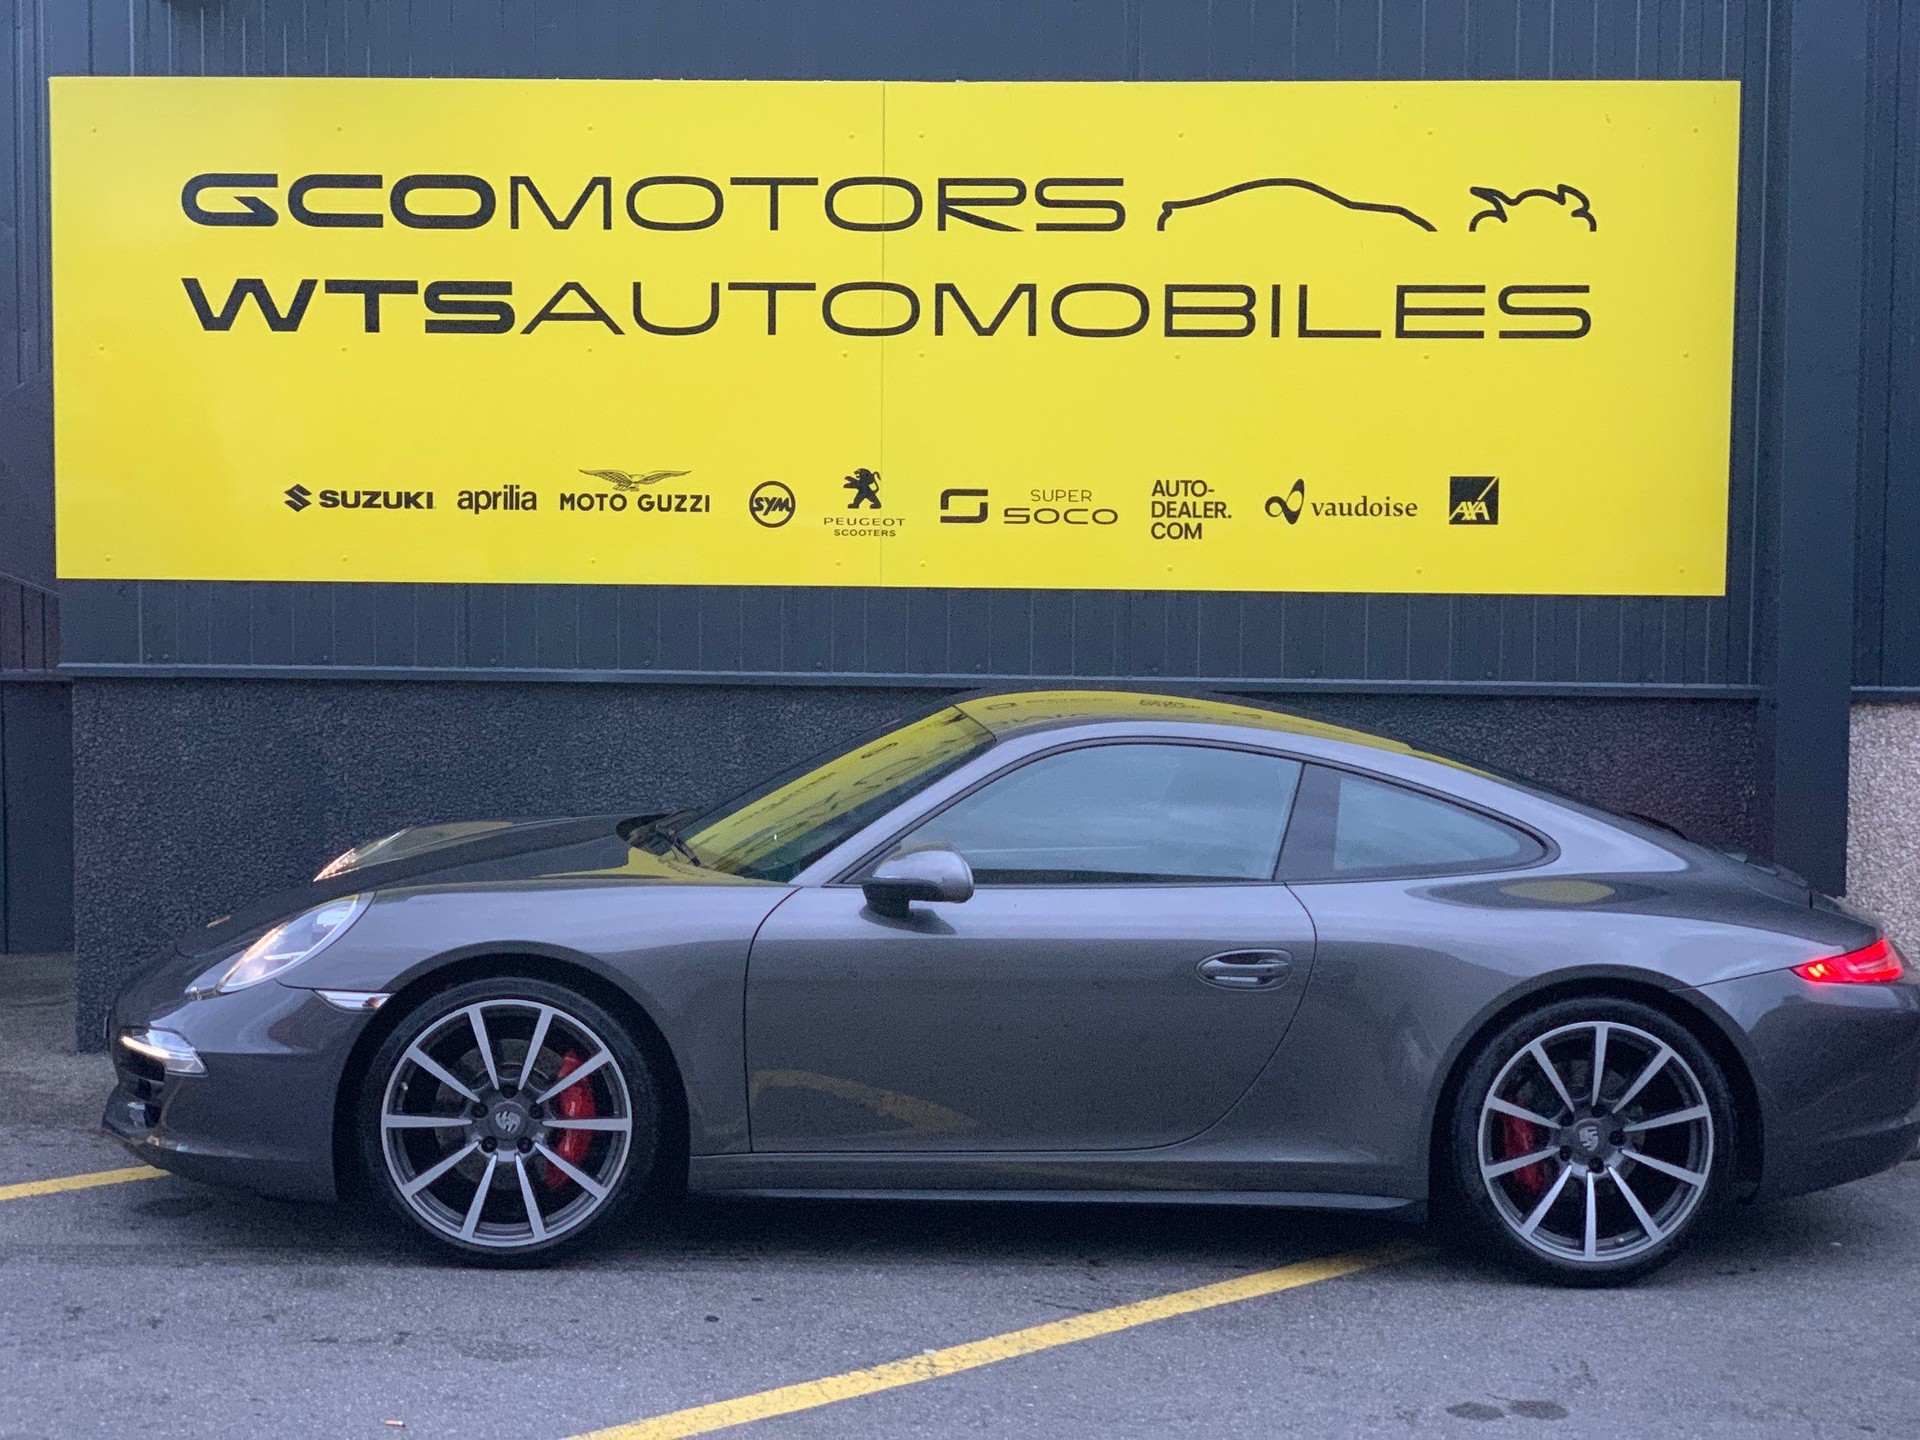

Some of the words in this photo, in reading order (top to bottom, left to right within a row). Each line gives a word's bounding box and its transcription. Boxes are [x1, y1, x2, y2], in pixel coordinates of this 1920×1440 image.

[1030, 489, 1092, 503] SUPER
[1151, 479, 1215, 498] AUTO-
[319, 489, 433, 510] SUZUKI
[456, 484, 538, 515] aprilia
[559, 493, 627, 512] MOTO
[636, 493, 710, 513] GUZZI
[751, 496, 793, 516] SYM
[1310, 495, 1418, 517] vaudoise
[1003, 507, 1119, 525] SOCO
[1151, 500, 1232, 519] DEALER.
[1449, 501, 1490, 521] AXA
[823, 517, 905, 527] PEUGEOT
[1151, 521, 1203, 540] COM
[834, 529, 896, 537] SCOOTERS
